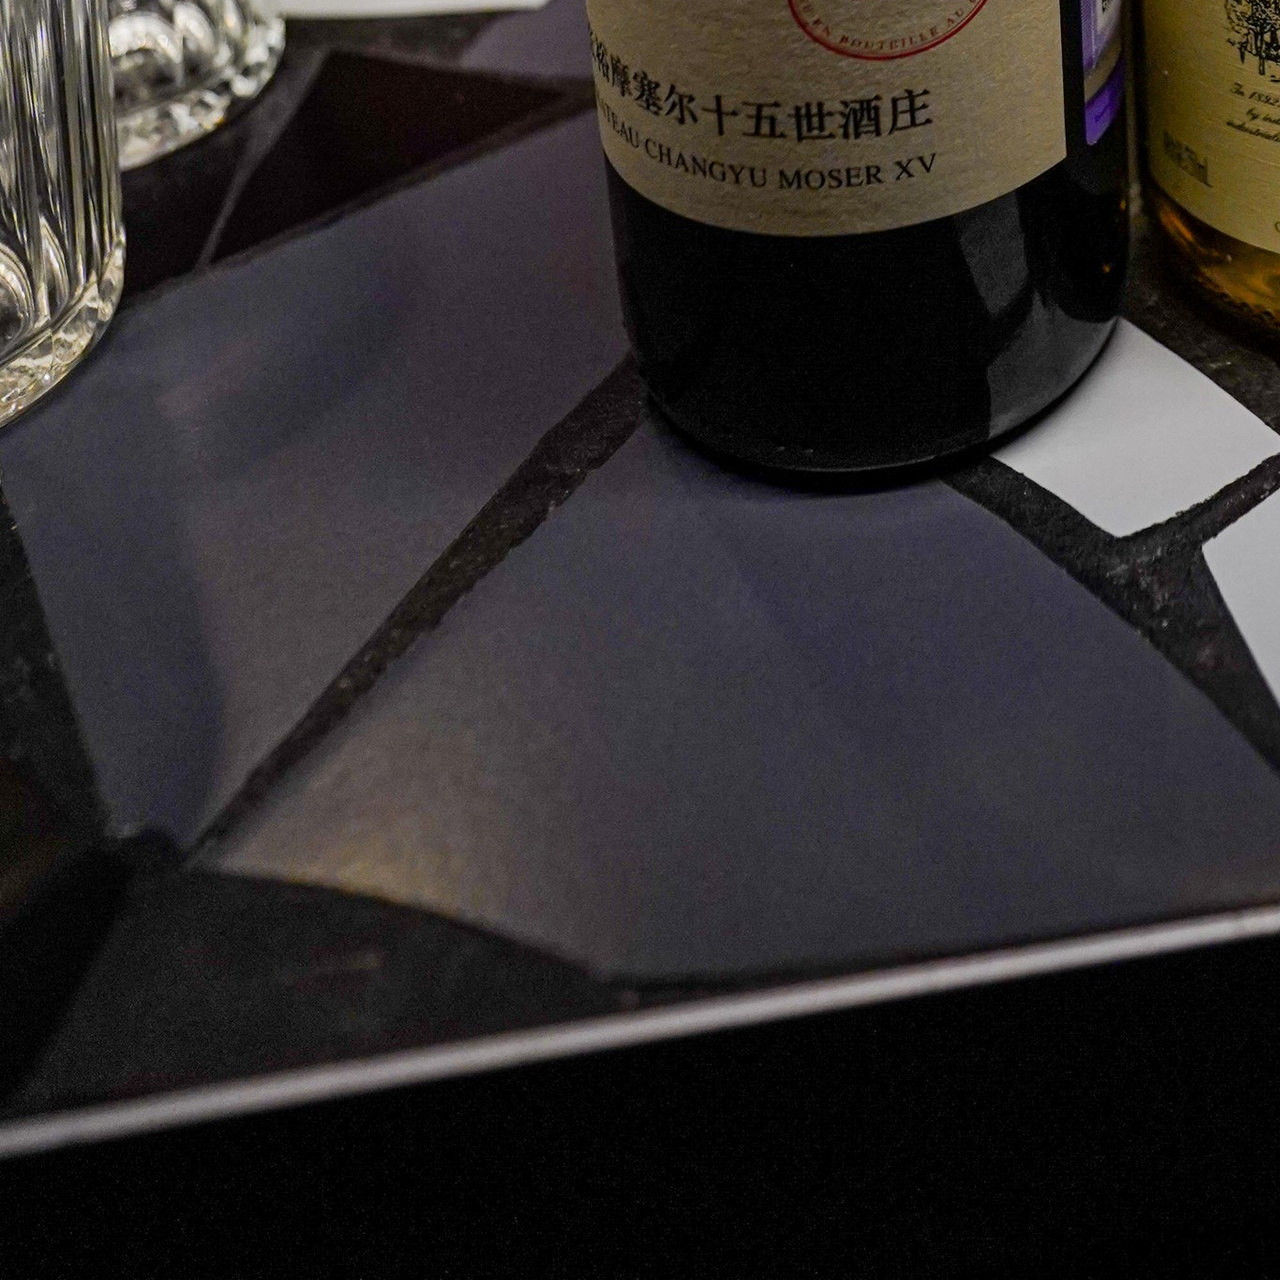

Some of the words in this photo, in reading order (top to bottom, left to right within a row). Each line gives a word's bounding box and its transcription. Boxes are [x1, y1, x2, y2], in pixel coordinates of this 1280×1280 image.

[644, 138, 768, 188] CHANGYU
[778, 164, 884, 190] MOSER
[893, 152, 937, 181] XV
